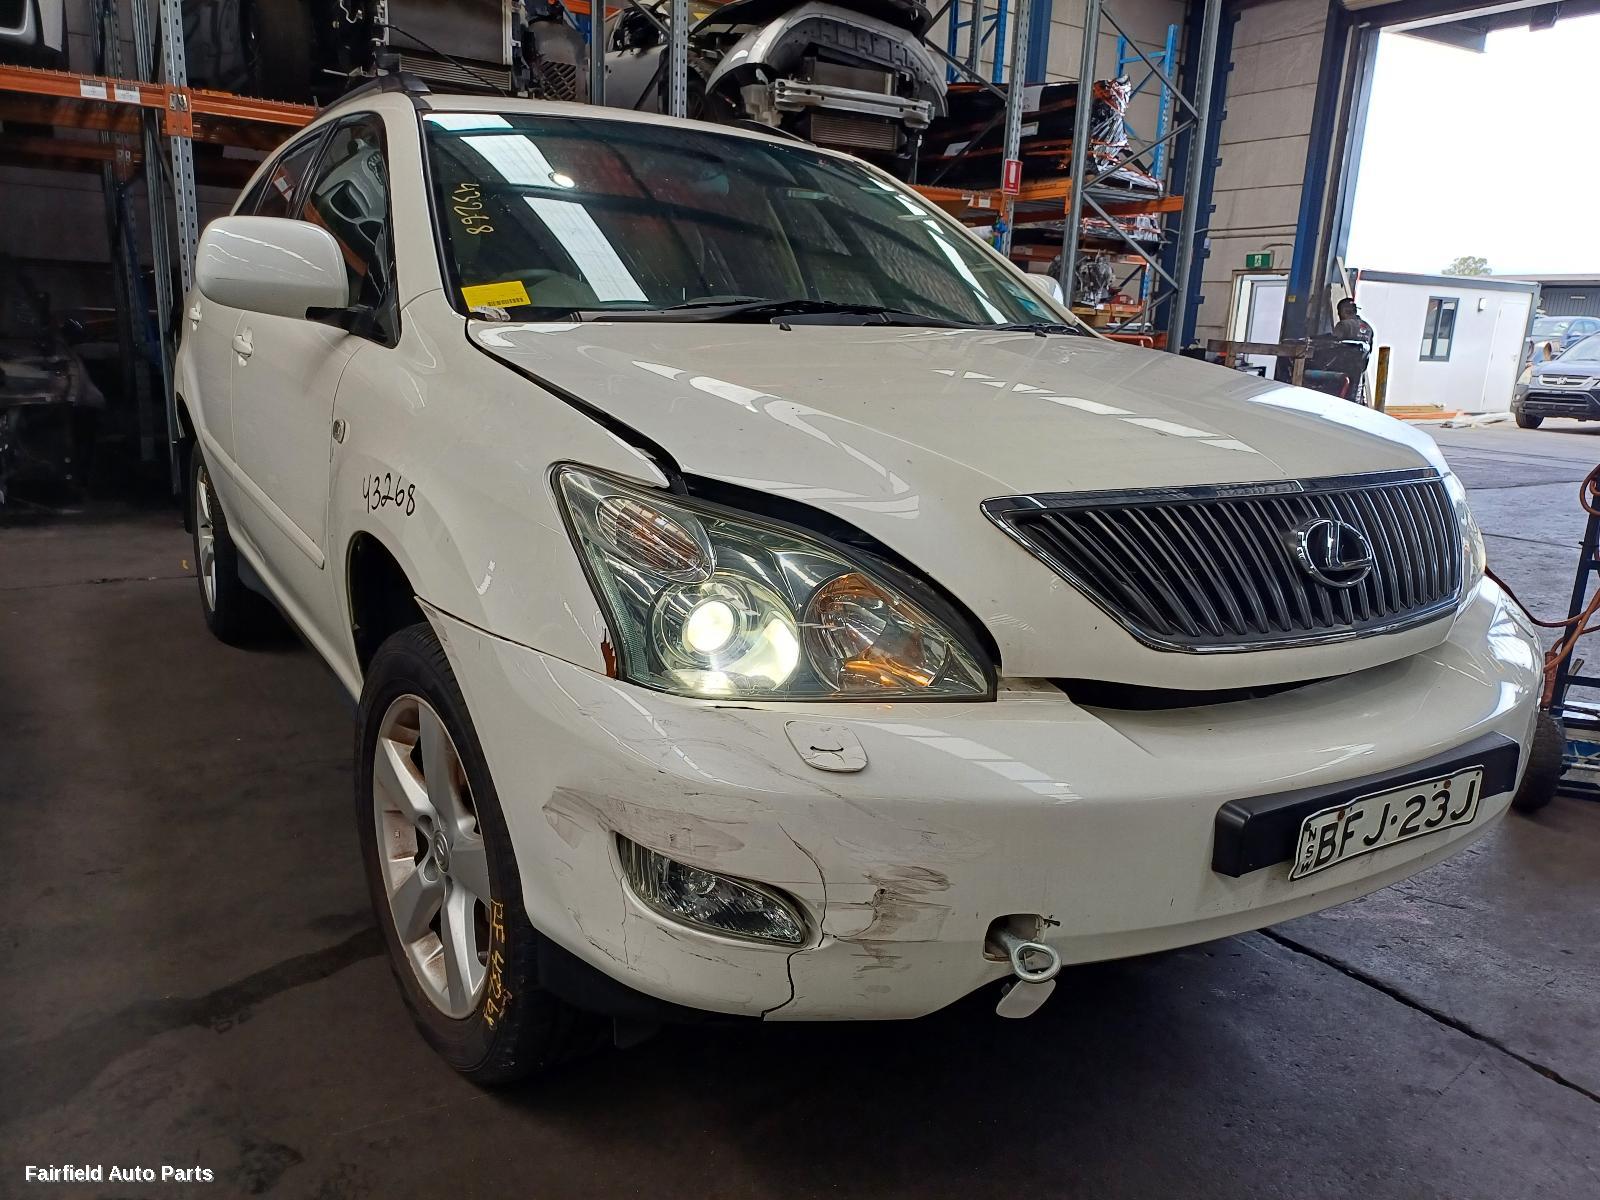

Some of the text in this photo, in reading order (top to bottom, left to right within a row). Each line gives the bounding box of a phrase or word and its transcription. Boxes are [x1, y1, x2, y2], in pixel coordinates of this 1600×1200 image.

[452, 183, 494, 234] 43268
[363, 472, 416, 517] 43268
[1300, 827, 1318, 873] NSW
